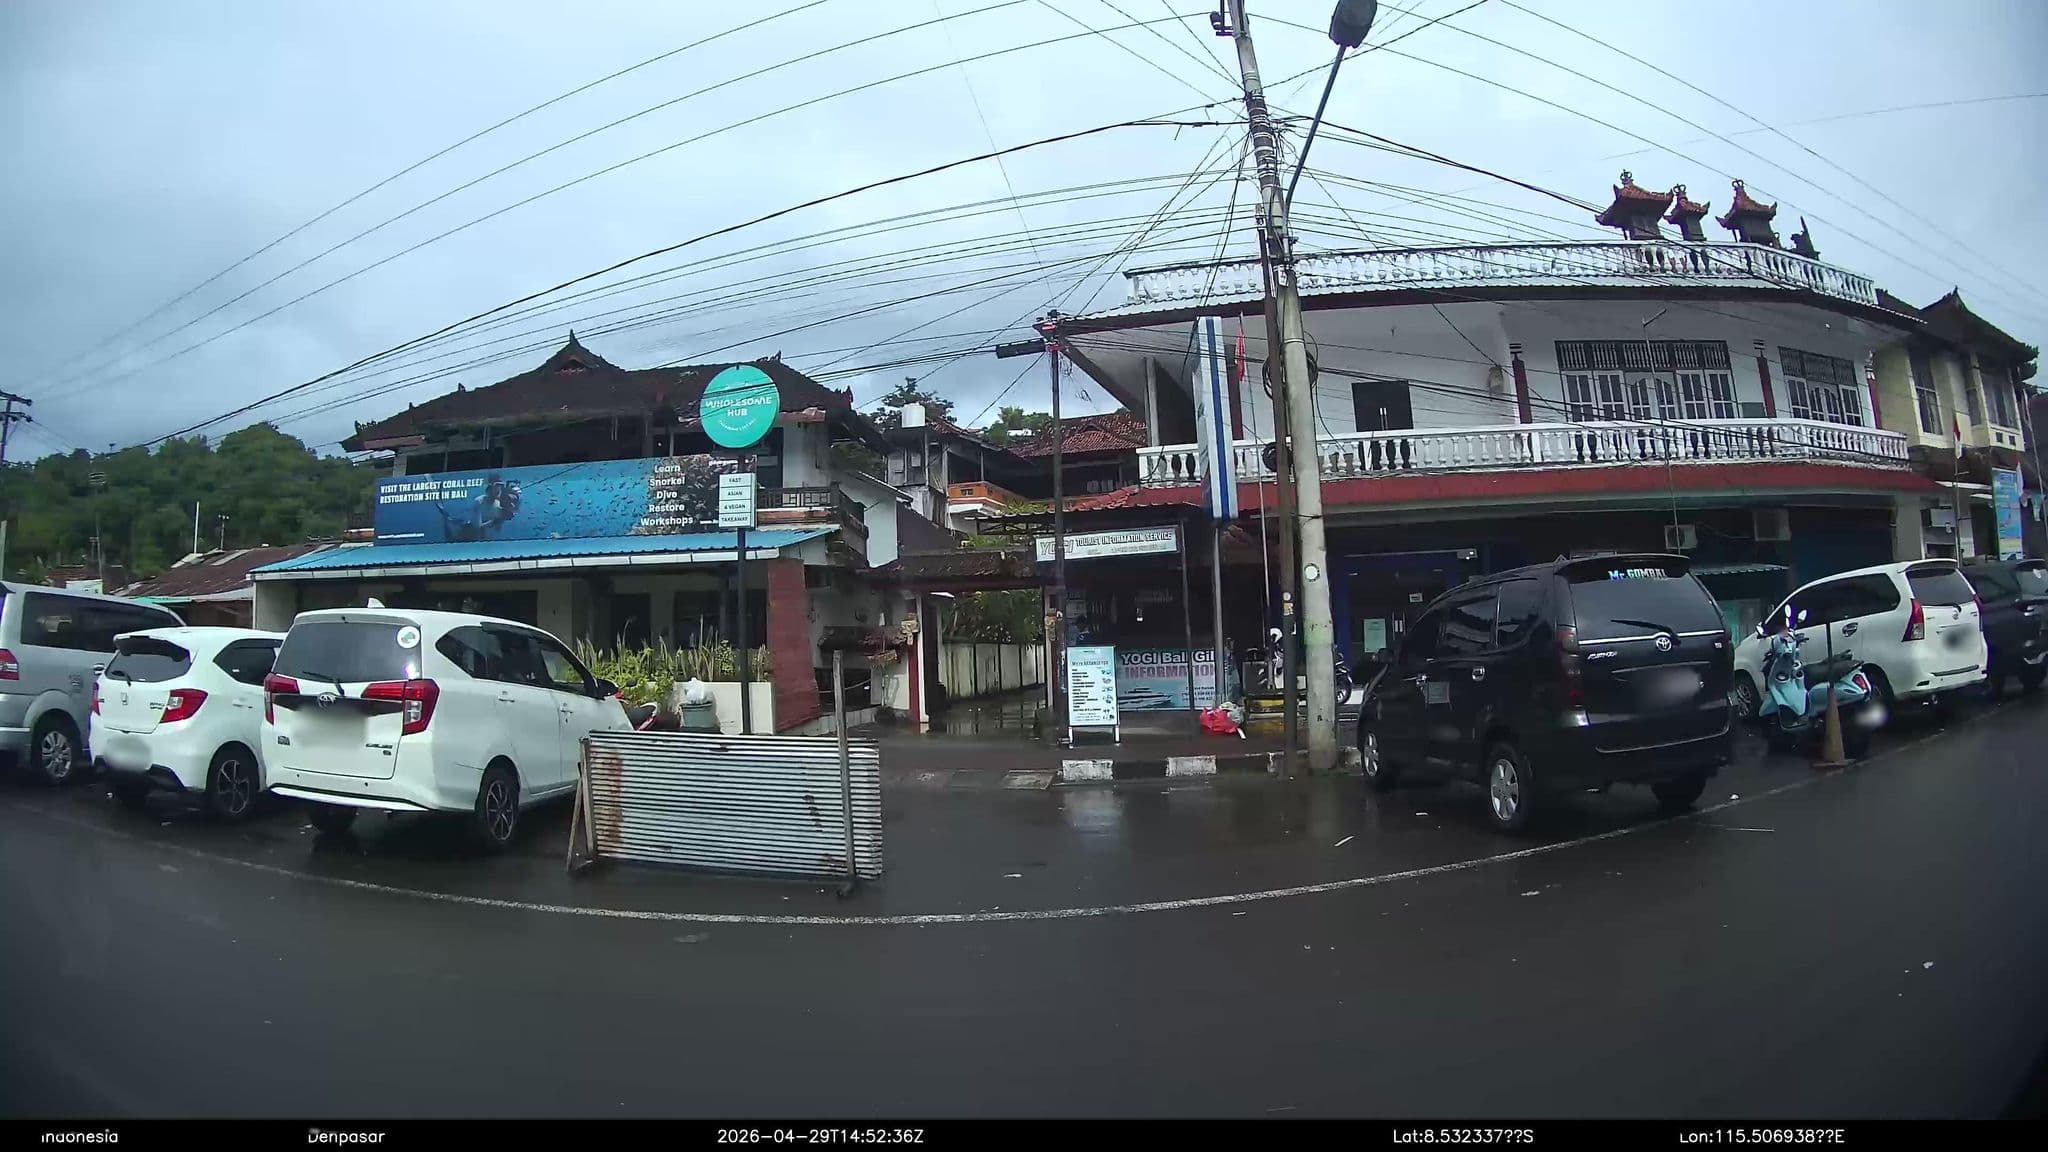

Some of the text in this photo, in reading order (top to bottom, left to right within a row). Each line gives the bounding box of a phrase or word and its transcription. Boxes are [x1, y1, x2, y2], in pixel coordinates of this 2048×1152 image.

[705, 396, 772, 408] WHOLESOME
[727, 408, 748, 417] HUB
[654, 464, 681, 473] Learn
[380, 478, 484, 493] VISIT THE LARGEST CORAL REEF
[649, 476, 685, 487] Snorkel
[380, 490, 468, 504] RESTORATION SITE IN BALI
[656, 490, 678, 500] Dive
[649, 503, 685, 513] Restore
[640, 516, 694, 527] Workshops
[1076, 536, 1101, 547] TOURIST
[1101, 534, 1145, 545] INFORMATION
[1145, 531, 1172, 542] SERVICE
[1121, 652, 1157, 664] YOGI
[1162, 651, 1188, 663] Bal
